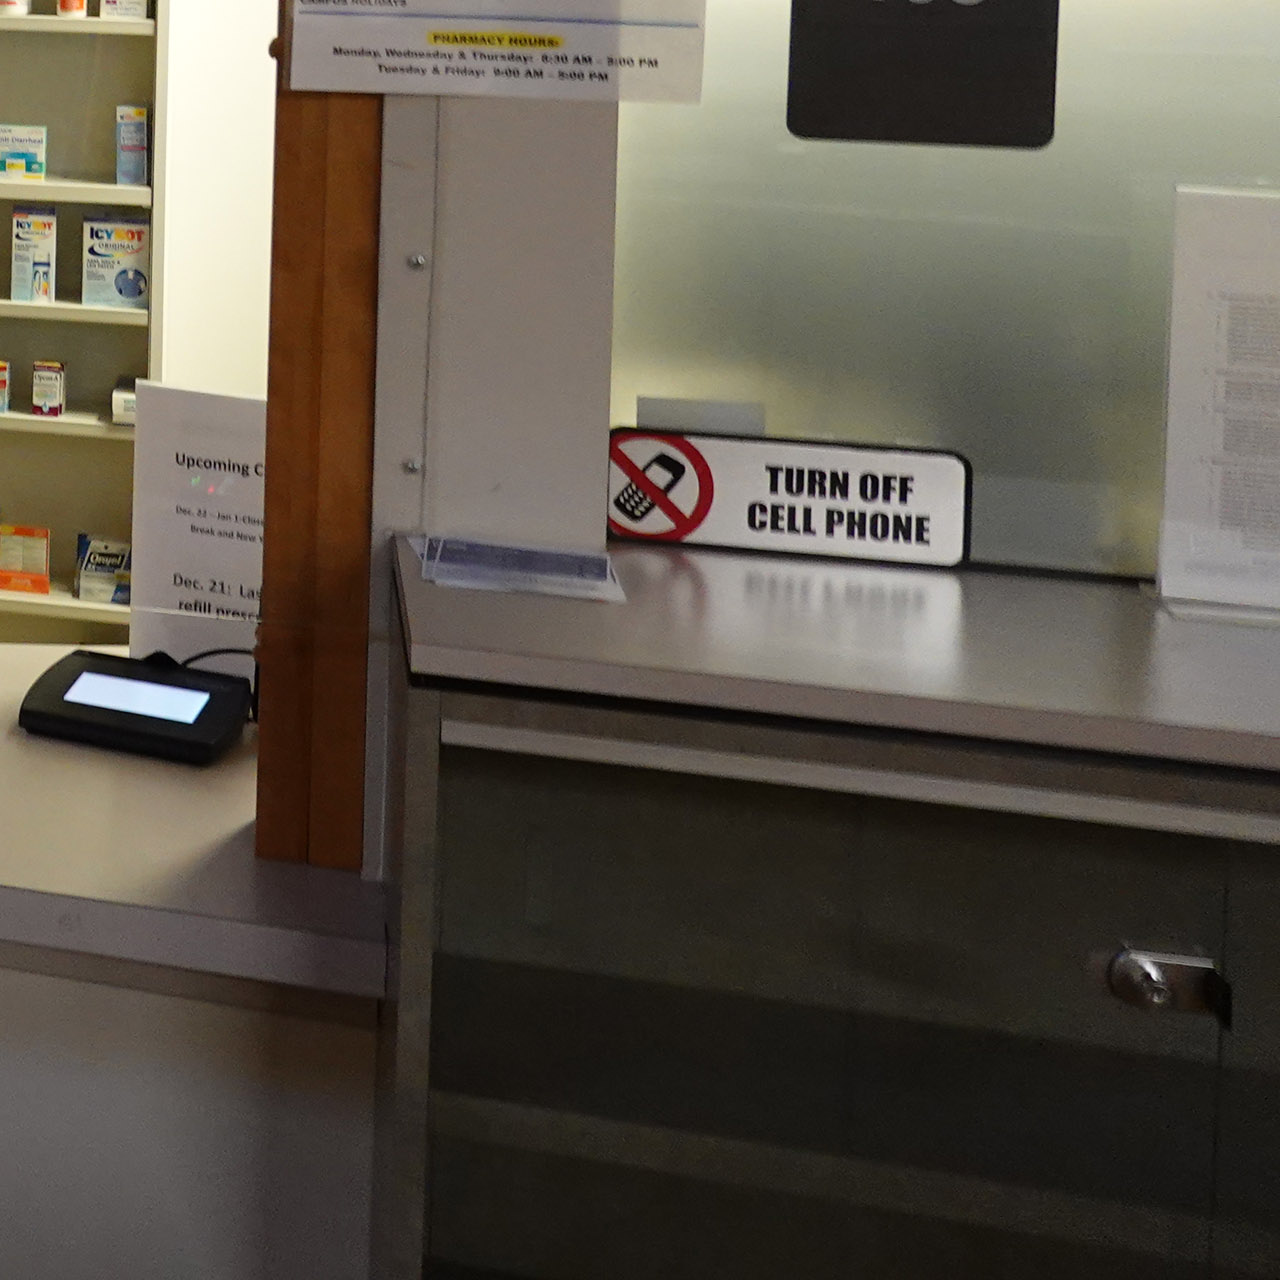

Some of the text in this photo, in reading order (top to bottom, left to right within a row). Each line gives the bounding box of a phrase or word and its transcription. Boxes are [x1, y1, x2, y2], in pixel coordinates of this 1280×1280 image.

[433, 34, 560, 47] PHARMACY HOURS:
[332, 46, 659, 68] Monday, Wednesday & Thursday: AM PM
[377, 64, 609, 82] Tuesday & Friday: AM PM
[11, 136, 43, 145] Diarrheal
[98, 242, 135, 251] ORIGINAL
[175, 452, 250, 478] Upcoming
[765, 465, 915, 505] TURN OFF
[175, 504, 193, 518] Dec.
[216, 512, 232, 521] Jan
[747, 501, 931, 546] CELL PHONE
[190, 524, 256, 542] Break and New
[173, 572, 231, 596] Dec. 21:
[178, 599, 211, 614] refill
